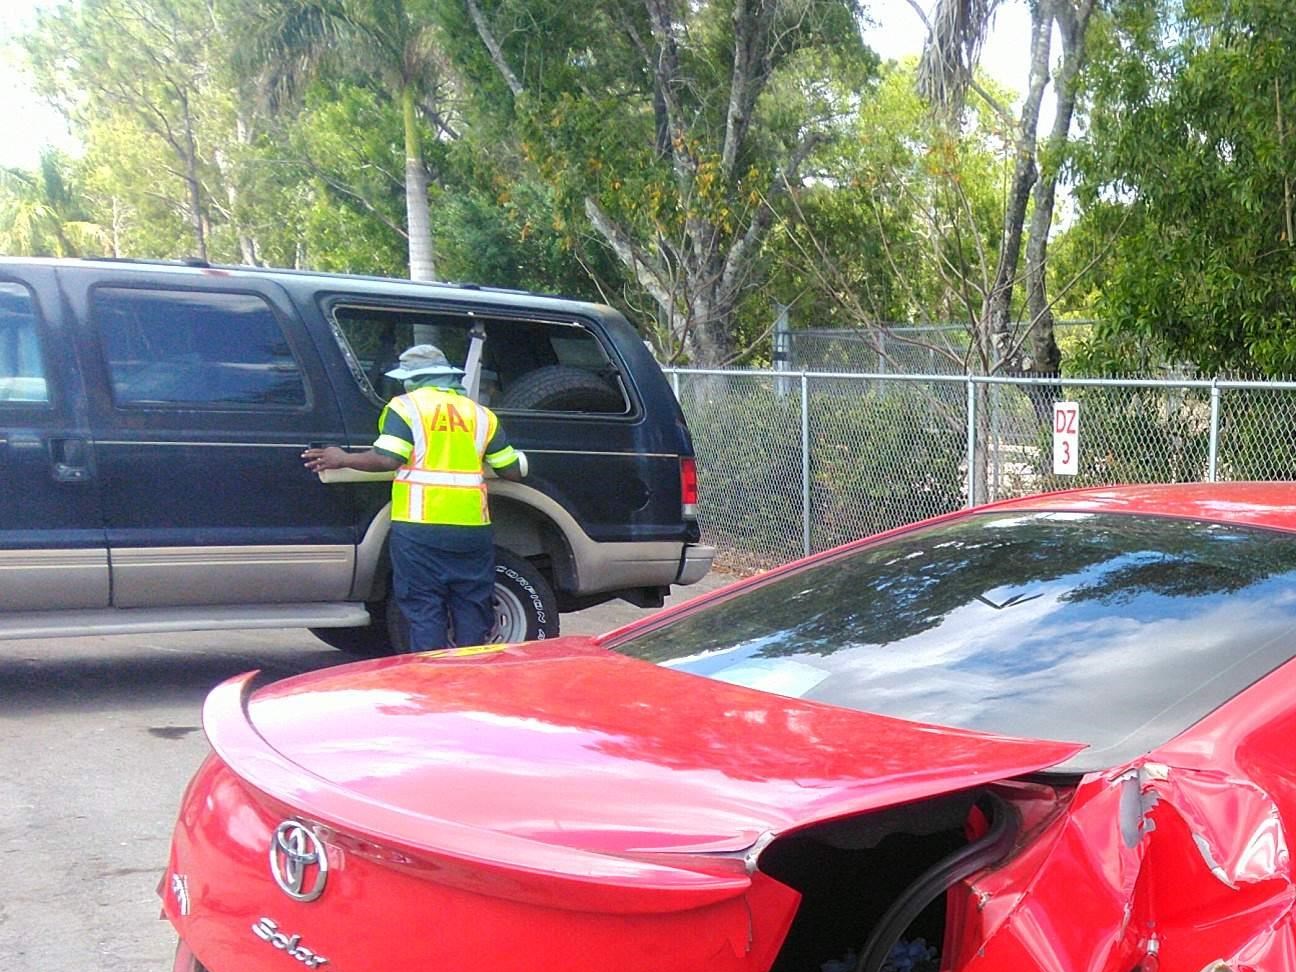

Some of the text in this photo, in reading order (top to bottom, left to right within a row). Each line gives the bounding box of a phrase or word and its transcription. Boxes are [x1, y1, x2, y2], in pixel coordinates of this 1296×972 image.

[1056, 409, 1077, 434] DZ
[1062, 440, 1071, 465] 3
[496, 565, 546, 624] CORPION
